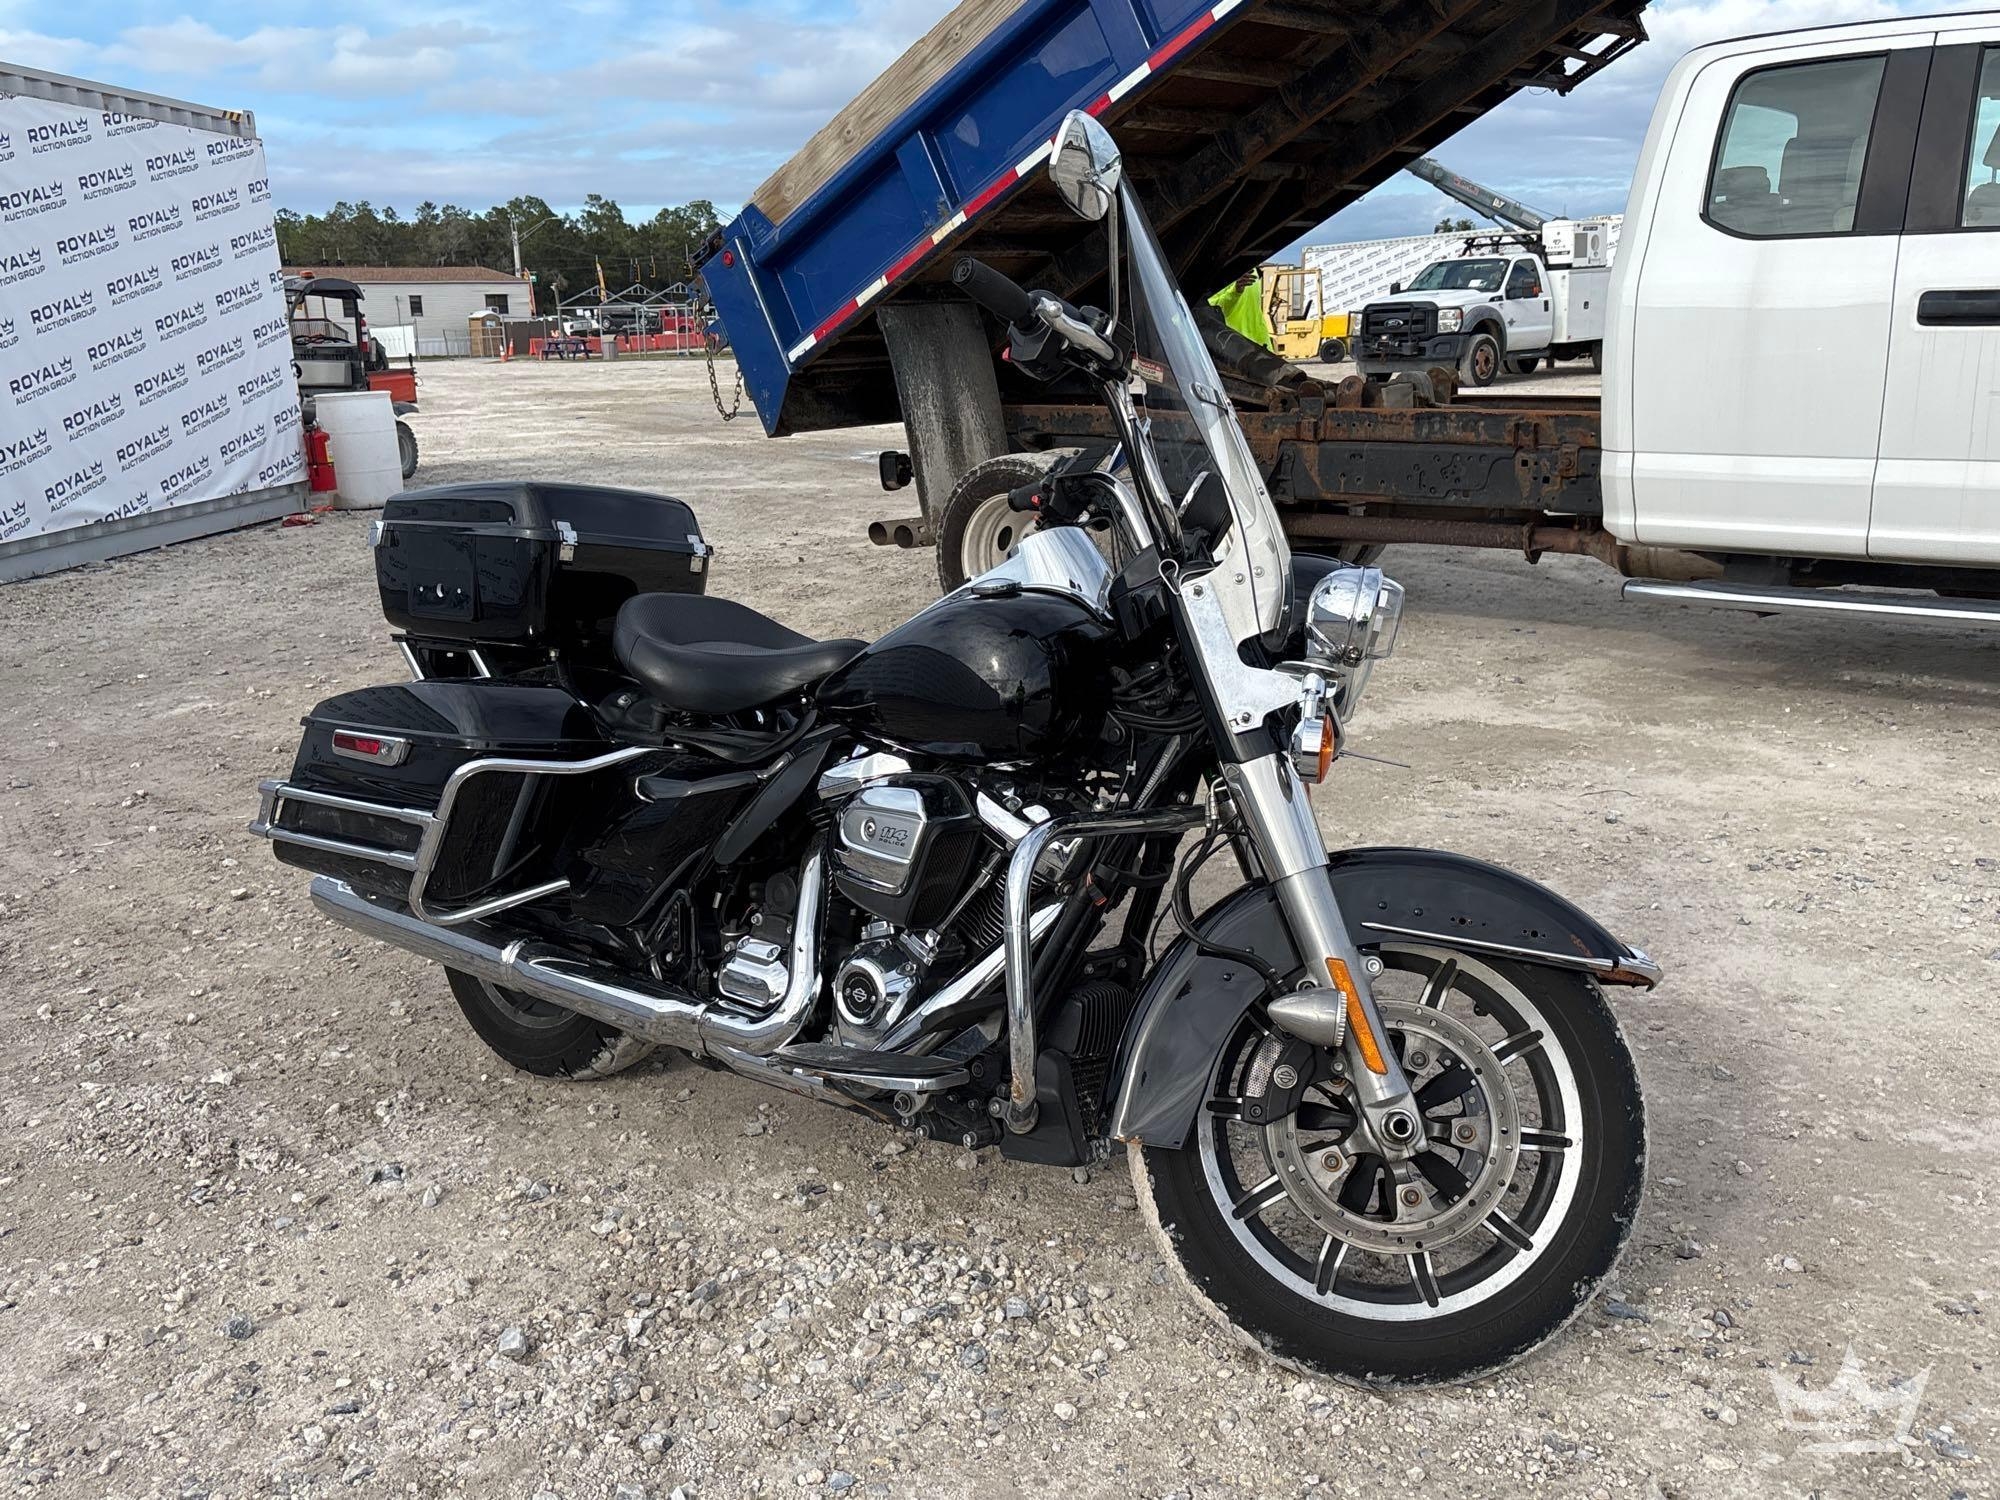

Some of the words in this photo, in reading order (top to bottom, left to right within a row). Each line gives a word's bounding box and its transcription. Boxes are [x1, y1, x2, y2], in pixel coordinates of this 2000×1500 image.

[27, 121, 77, 142] ROYAL
[33, 139, 66, 154] AUCTION
[66, 134, 92, 146] GROUP
[106, 125, 136, 138] AUCTION
[206, 137, 242, 156] ROYAL
[211, 153, 235, 165] AUCTION
[235, 148, 253, 159] GROUP
[145, 151, 186, 172] ROYAL
[151, 168, 177, 182] AUCTION
[177, 162, 198, 174] GROUP
[78, 167, 123, 190] ROYAL
[83, 185, 114, 200] AUCTION
[113, 179, 137, 192] GROUP
[248, 178, 269, 195] ROY
[0, 186, 51, 210] ROYAL
[5, 205, 40, 222] AUCTION
[39, 198, 66, 212] GROUP
[192, 191, 229, 212] ROYAL
[252, 192, 272, 203] AUCTIO
[128, 209, 170, 232] ROYAL
[197, 207, 221, 221] AUCTION
[221, 201, 240, 213] GROUP
[57, 229, 105, 254] ROYAL
[133, 226, 161, 242] AUCTION
[161, 219, 182, 232] GROUP
[230, 229, 264, 250] ROYAL
[63, 248, 94, 265] AUCTION
[94, 240, 119, 254] GROUP
[171, 248, 210, 272] ROYAL
[235, 245, 257, 259] AUCTION
[257, 238, 275, 250] GROUP
[0, 253, 29, 273] YAL
[0, 273, 18, 287] TION
[18, 264, 46, 281] GROUP
[176, 265, 202, 281] AUCTION
[202, 258, 222, 271] GROUP
[105, 270, 150, 296] ROYAL
[111, 288, 140, 306] AUCTION
[140, 280, 162, 294] GROUP
[216, 283, 251, 307] ROYAL
[30, 296, 81, 324] ROYAL
[220, 300, 244, 316] AUCTION
[244, 292, 262, 305] GROUP
[37, 315, 70, 335] AUCTION
[70, 305, 95, 322] GROUP
[155, 306, 195, 332] ROYAL
[160, 324, 186, 342] AUCTION
[186, 315, 207, 330] GROUP
[253, 317, 286, 341] ROYAL
[87, 333, 133, 361] ROYAL
[93, 352, 123, 371] AUCTION
[123, 342, 146, 358] GROUP
[196, 341, 233, 367] ROYAL
[201, 358, 226, 376] AUCTION
[225, 349, 244, 364] GROUP
[8, 363, 61, 395] ROYAL
[15, 384, 50, 406] AUCTION
[50, 372, 76, 390] GROUP
[134, 368, 176, 397] ROYAL
[139, 387, 167, 407] AUCTION
[167, 376, 188, 393] GROUP
[238, 371, 272, 397] ROYAL
[243, 388, 265, 406] AUCTION
[265, 378, 283, 393] GROUP
[62, 400, 110, 432] ROYAL
[69, 420, 100, 442] AUCTION
[100, 408, 124, 426] GROUP
[180, 399, 219, 428] ROYAL
[186, 417, 211, 437] AUCTION
[211, 406, 230, 423] GROUP
[274, 404, 300, 427] ROYA
[0, 436, 36, 464] OYAL
[116, 431, 159, 462] ROYAL
[122, 450, 150, 472] AUCTION
[150, 438, 172, 456] GROUP
[220, 430, 255, 458] ROYAL
[224, 447, 248, 467] AUCTION
[248, 436, 266, 452] GROUP
[0, 460, 26, 478] CTION
[27, 444, 53, 464] GROUP
[258, 456, 294, 483] ROYAL
[45, 468, 92, 503] ROYAL
[160, 462, 200, 493] ROYAL
[165, 481, 192, 502] AUCTION
[191, 468, 212, 486] GROUP
[49, 489, 82, 513] AUCTION
[81, 474, 107, 494] GROUP
[4, 517, 31, 538] GROUP
[879, 838, 905, 847] POLICE
[881, 827, 908, 841] 114
